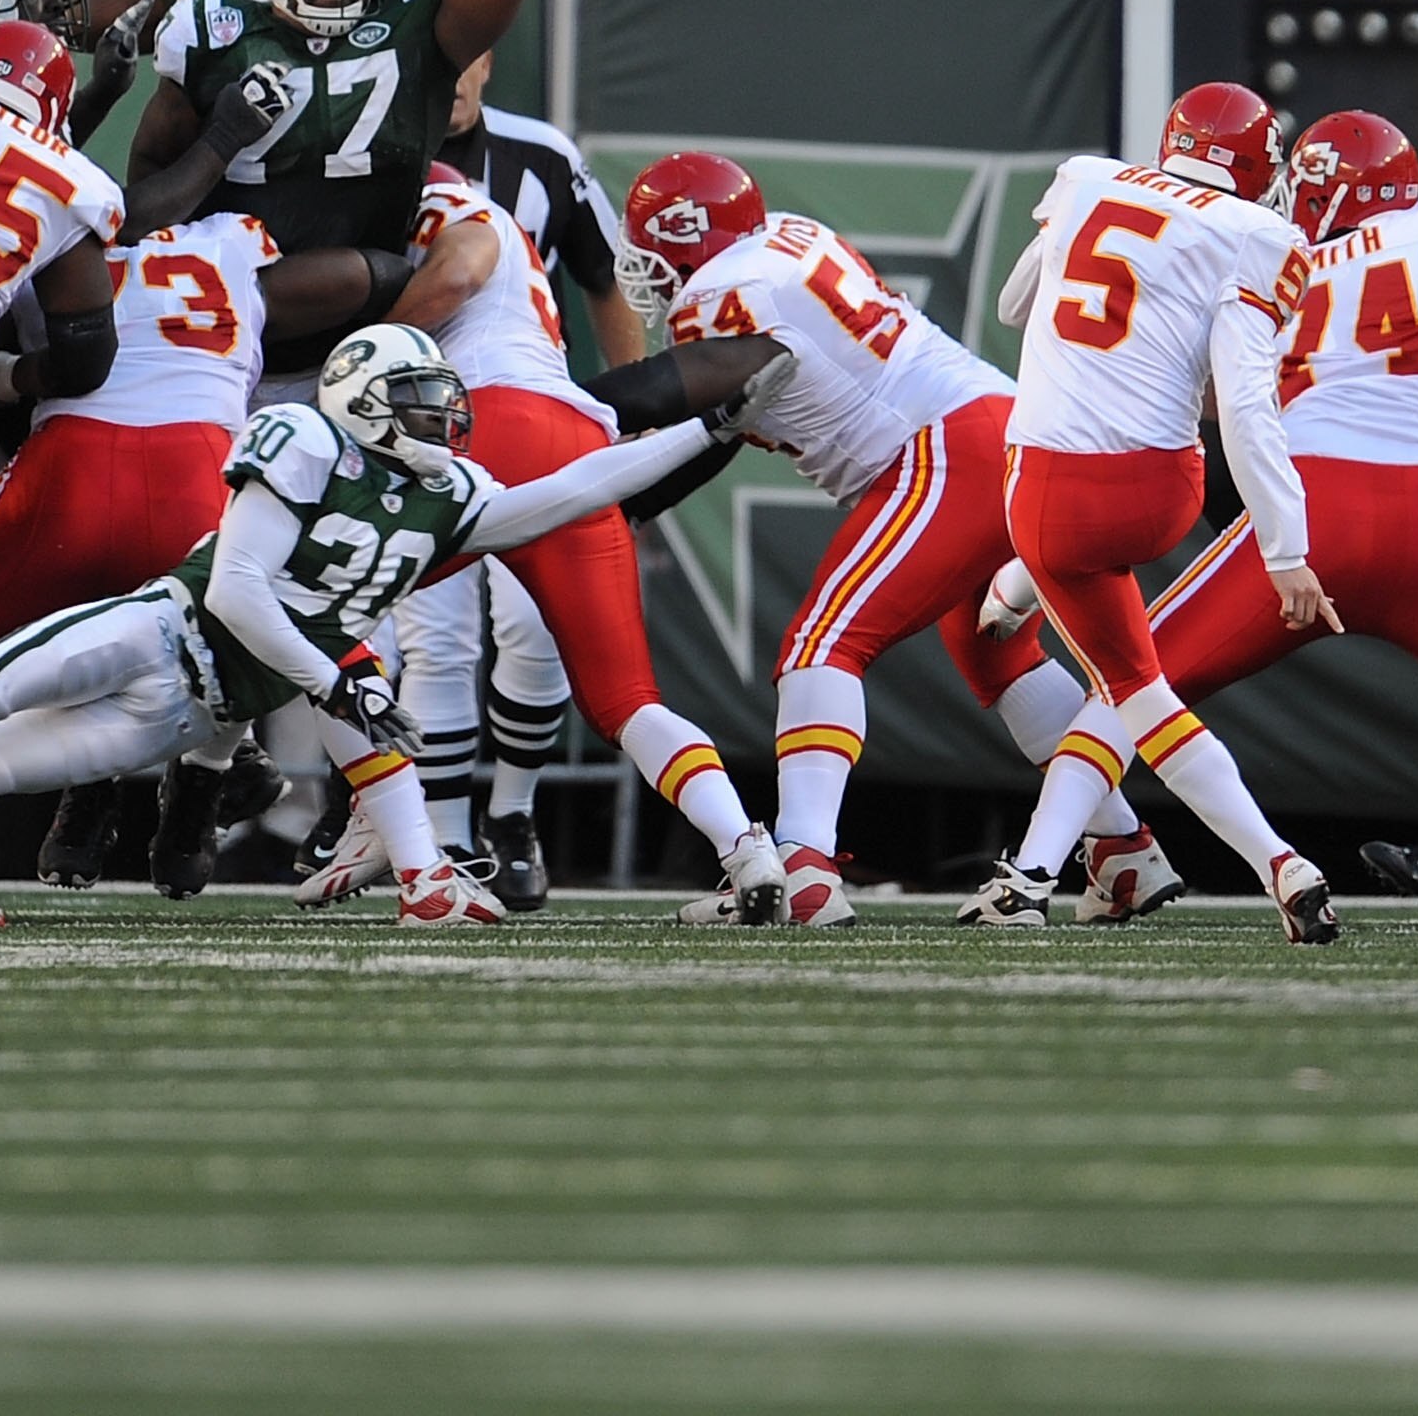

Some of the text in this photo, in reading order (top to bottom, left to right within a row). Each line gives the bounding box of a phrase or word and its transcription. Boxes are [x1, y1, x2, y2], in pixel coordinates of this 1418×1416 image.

[225, 49, 401, 184] 77
[1054, 196, 1172, 354] 5
[1310, 224, 1382, 269] MITH
[667, 287, 759, 345] 54
[273, 512, 437, 641] 30
